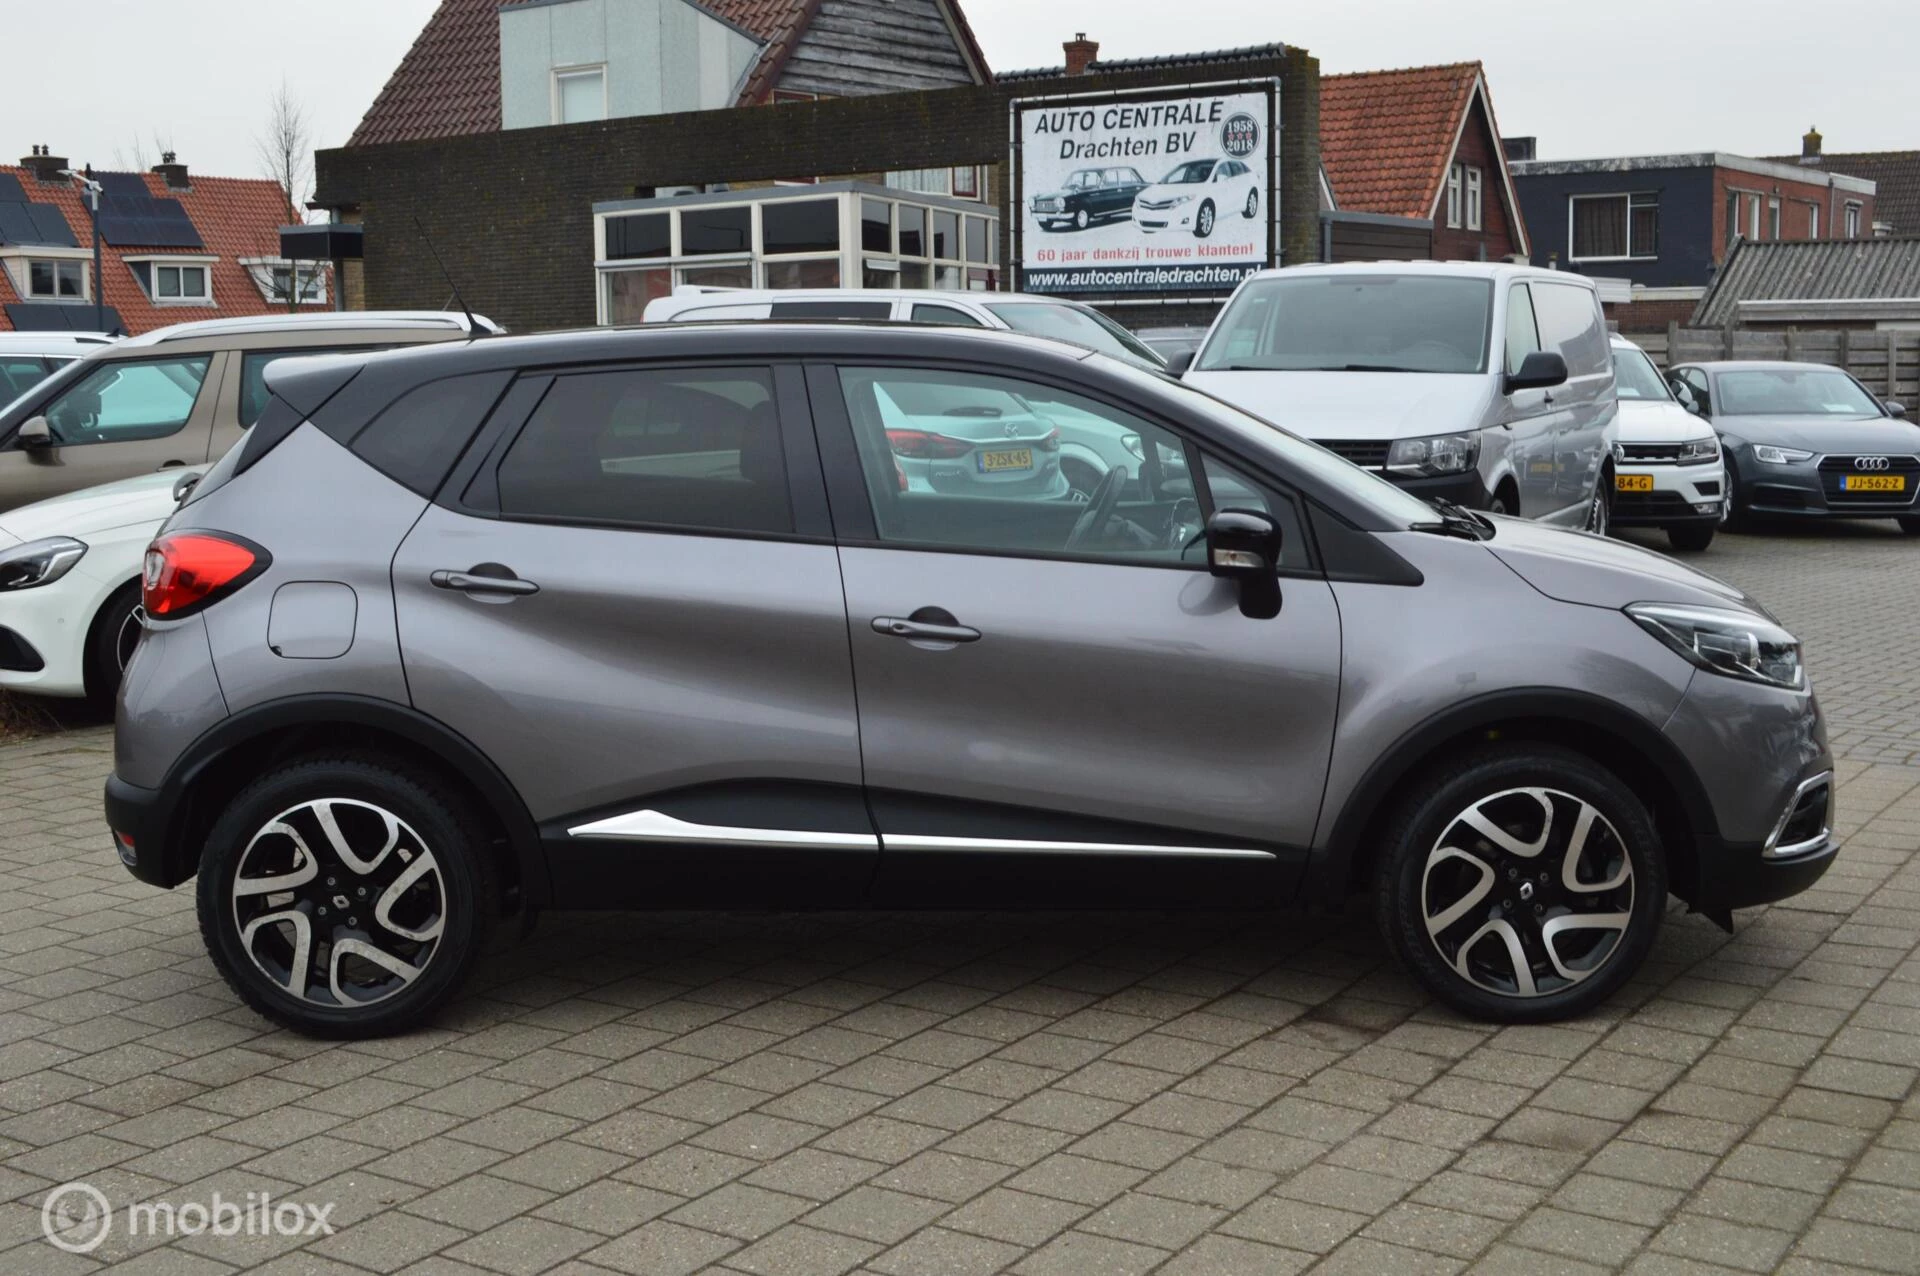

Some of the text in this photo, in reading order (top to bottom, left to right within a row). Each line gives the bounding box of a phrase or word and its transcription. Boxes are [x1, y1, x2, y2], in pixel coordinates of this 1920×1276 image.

[1035, 101, 1224, 134] AUTO CENTRALE
[1227, 120, 1254, 132] 1958
[1060, 131, 1197, 159] Drachten BV
[1226, 140, 1254, 152] 2018
[1037, 243, 1254, 262] 60 jaar dankzij trouwe klanten!
[1850, 477, 1899, 489] JJ-562-Z
